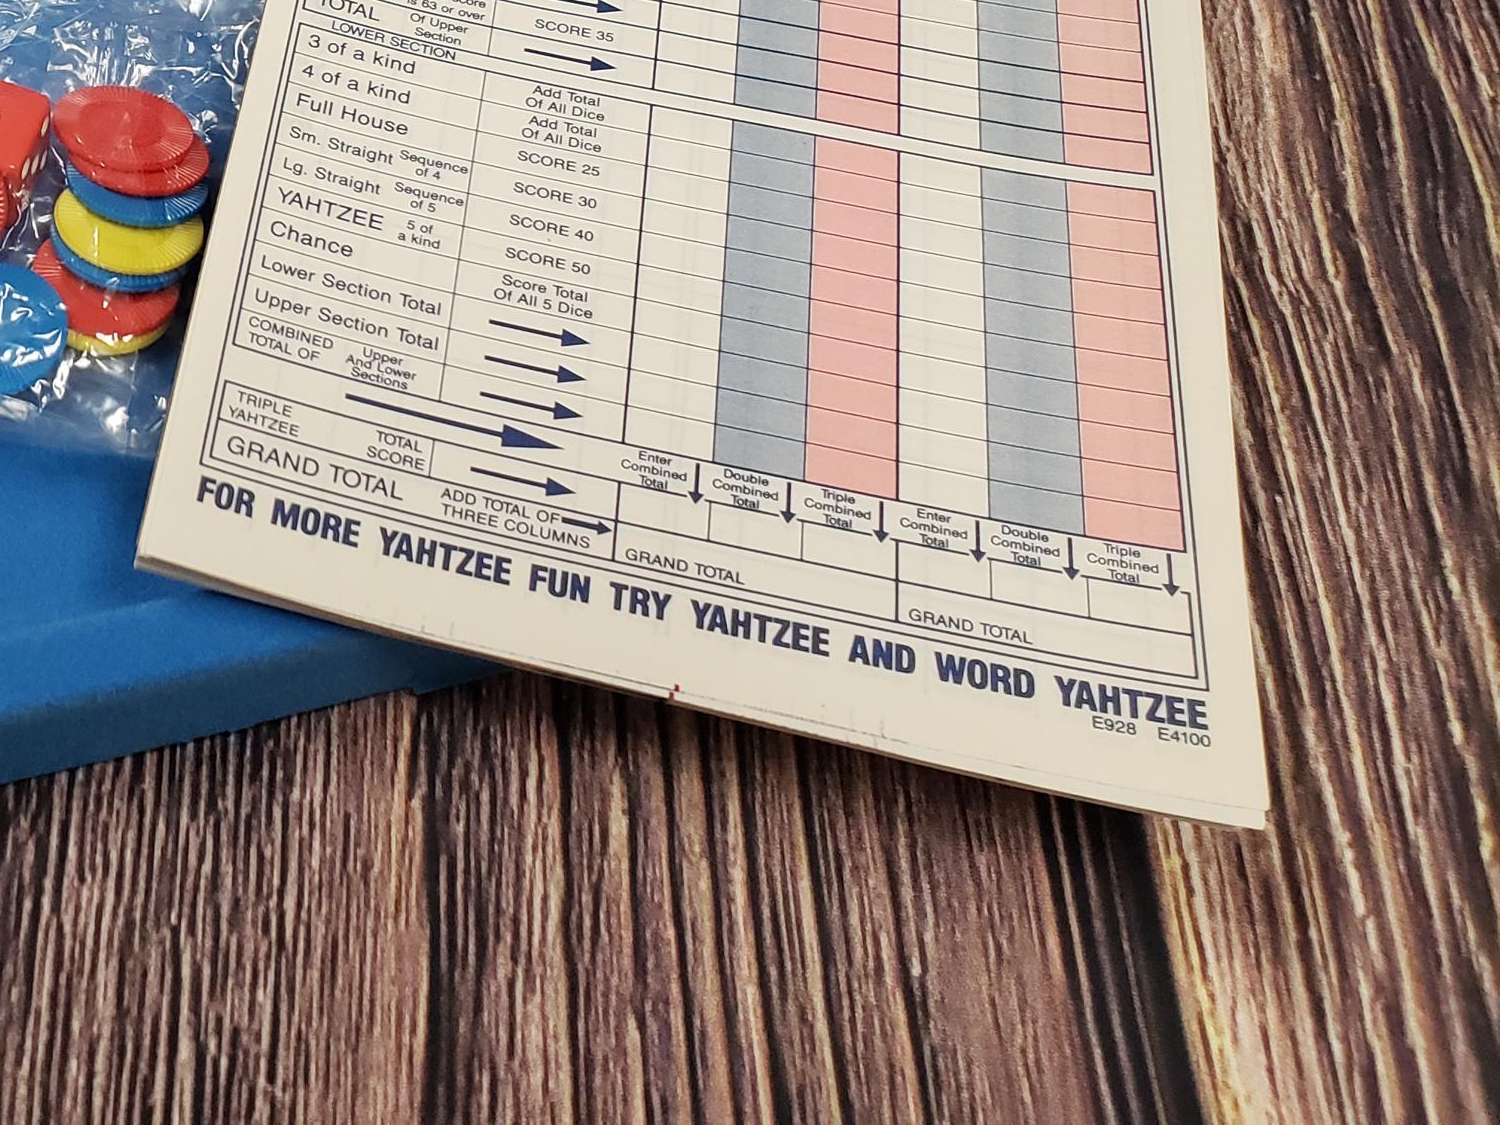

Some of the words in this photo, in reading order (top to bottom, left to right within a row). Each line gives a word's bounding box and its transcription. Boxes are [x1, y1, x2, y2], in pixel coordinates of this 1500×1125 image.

[409, 12, 427, 24] Of
[429, 17, 469, 34] Upper
[414, 26, 462, 46] Section
[534, 18, 592, 39] SCORE
[595, 30, 614, 43] 35
[307, 34, 321, 49] 3
[327, 42, 348, 56] of
[352, 49, 365, 62] a
[372, 50, 416, 75] kind
[331, 19, 386, 44] LOWER
[389, 35, 457, 61] SECTION
[301, 64, 315, 78] 4
[321, 71, 342, 86] of
[346, 78, 359, 92] a
[366, 80, 411, 105] kind
[532, 84, 562, 100] Add
[566, 91, 601, 108] Total
[296, 92, 334, 117] Full
[340, 105, 409, 136] House
[525, 96, 544, 109] Of
[547, 101, 567, 114] All
[571, 105, 605, 122] Dice
[289, 125, 321, 146] Sm.
[327, 137, 394, 165] Straight
[283, 156, 308, 177] Lg.
[314, 166, 381, 196] Straight
[399, 149, 469, 175] Sequence
[516, 150, 577, 173] SCORE
[581, 163, 600, 177] 25
[277, 186, 385, 231] YAHTZEE
[394, 181, 465, 207] Sequence
[512, 181, 574, 205] SCORE
[577, 195, 598, 209] 30
[270, 220, 354, 258] Chance
[508, 213, 570, 238] SCORE
[574, 229, 594, 242] 40
[504, 246, 567, 271] SCORE
[571, 261, 591, 275] 50
[260, 254, 317, 282] Lower
[321, 272, 392, 304] Section
[398, 292, 442, 316] Total
[501, 273, 548, 294] Score
[552, 284, 588, 303] Total
[255, 287, 313, 317] Upper
[317, 306, 389, 338] Section
[395, 326, 439, 351] Total
[493, 287, 513, 302] Of
[516, 293, 538, 308] All
[542, 298, 552, 311] 5
[557, 301, 593, 320] Dice
[248, 315, 334, 350] COMBINED
[248, 330, 293, 356] TOTAL
[297, 347, 321, 361] OF
[228, 404, 300, 438] YAHTZEE
[237, 390, 293, 419] TRIPLE
[366, 445, 426, 471] SCORE
[375, 429, 423, 454] TOTAL
[638, 449, 673, 466] Enter
[226, 435, 320, 477] GRAND
[328, 463, 404, 502] TOTAL
[620, 458, 688, 483] Combined
[638, 474, 668, 491] Total
[440, 487, 477, 506] ADD
[482, 495, 531, 520] TOTAL
[536, 509, 561, 524] OF
[441, 502, 499, 529] THREE
[503, 518, 590, 549] COLUMNS
[624, 548, 689, 573] GRAND
[693, 562, 746, 586] TOTAL
[195, 474, 256, 519] FOR
[270, 497, 362, 549] MORE
[379, 525, 513, 587] YAHTZEE
[528, 563, 592, 605] FUN
[608, 580, 673, 622] TRY
[690, 598, 830, 658] YAHTZEE
[847, 634, 916, 674] AND
[933, 651, 1036, 699] WORD
[1053, 674, 1210, 731] YAHTZEE
[908, 608, 974, 633] GRAND
[979, 622, 1034, 646] TOTAL
[1091, 714, 1137, 736] E928
[1157, 726, 1212, 748] E4100
